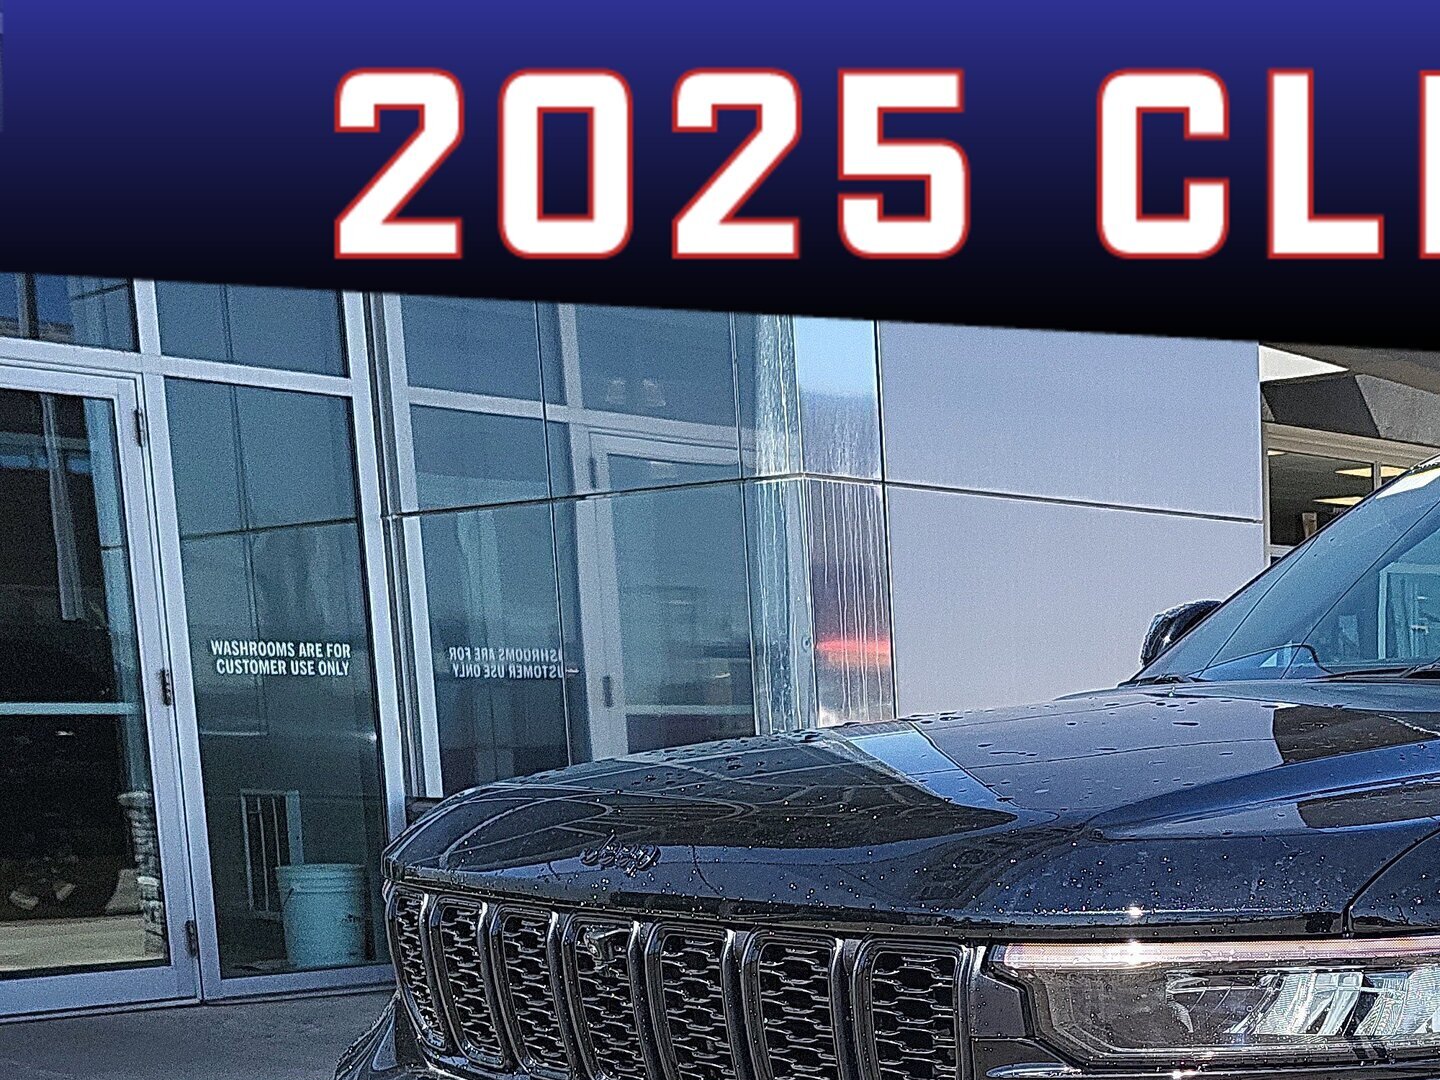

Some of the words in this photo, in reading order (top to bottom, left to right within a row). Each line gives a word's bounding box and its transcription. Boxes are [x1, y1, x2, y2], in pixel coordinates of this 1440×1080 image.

[210, 639, 295, 657] WASHROOMS
[299, 642, 323, 658] ARE
[326, 642, 351, 659] FOR
[216, 658, 287, 675] CUSTOMER
[291, 660, 316, 676] USE
[318, 660, 350, 676] ONLY
